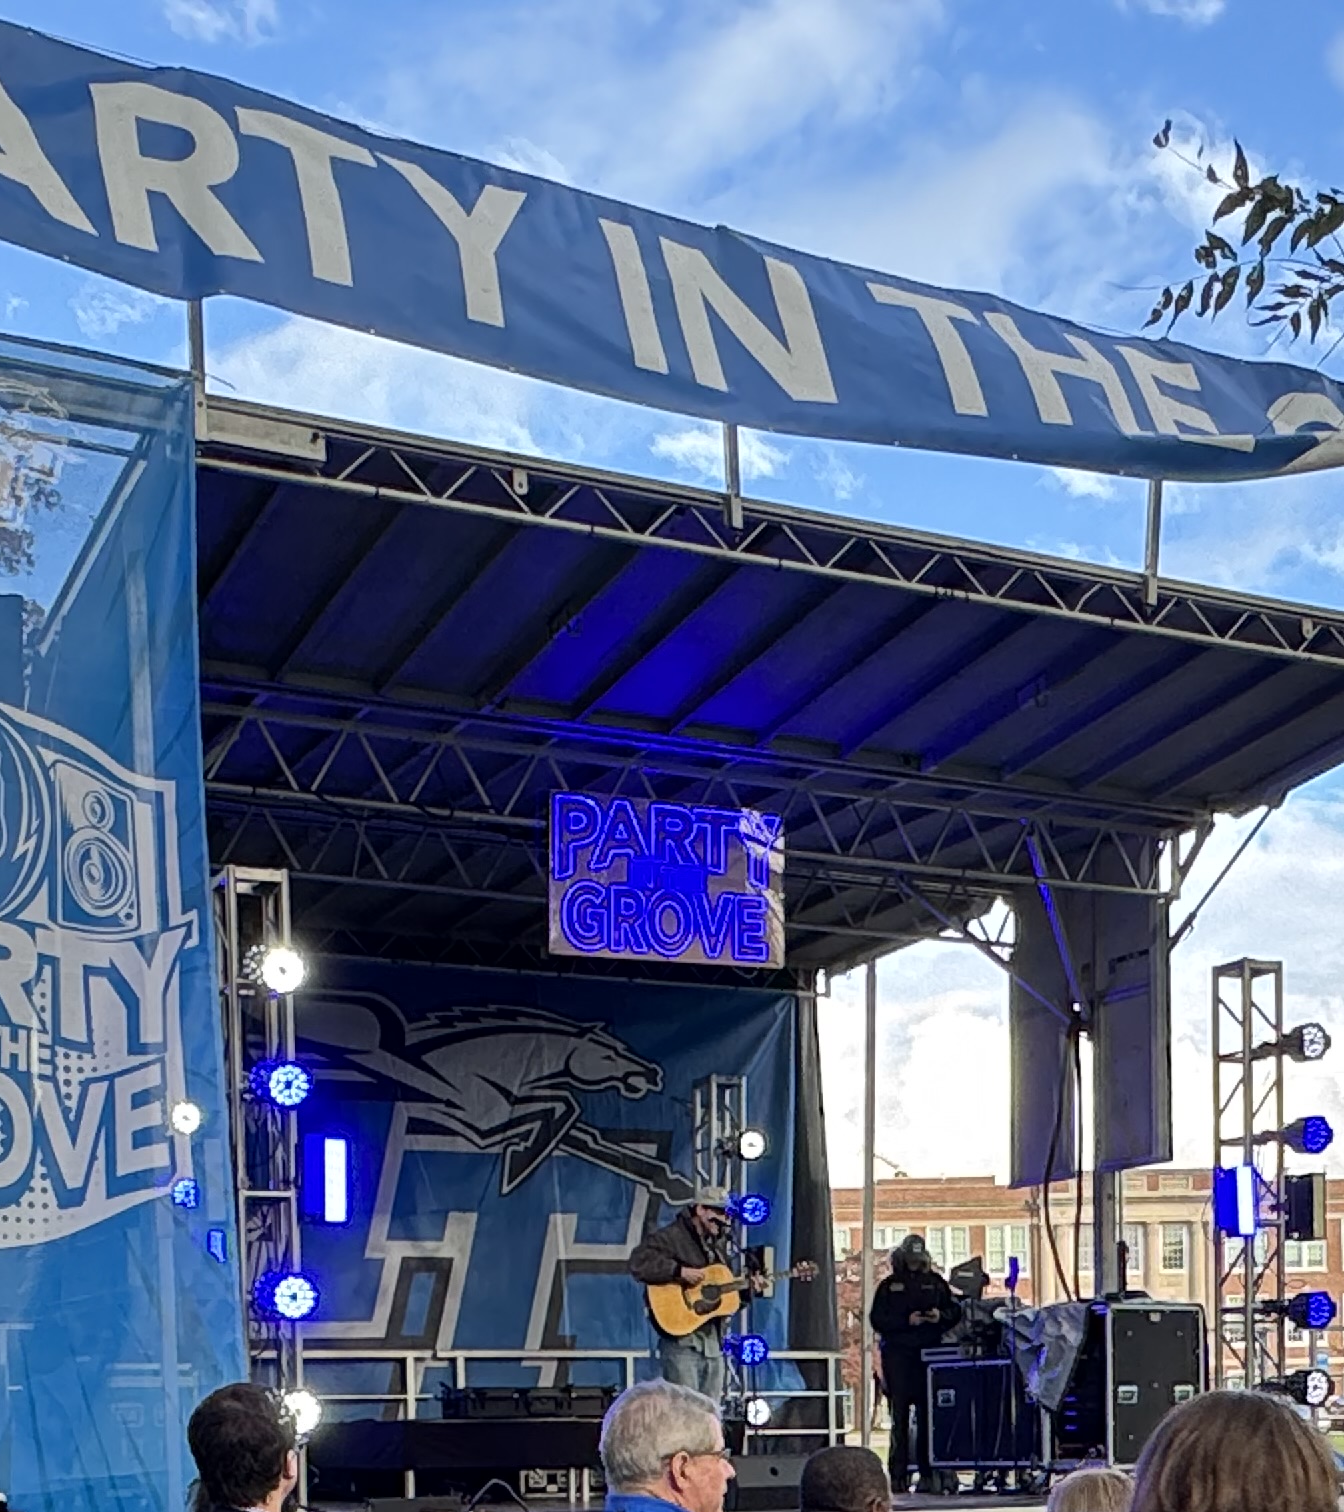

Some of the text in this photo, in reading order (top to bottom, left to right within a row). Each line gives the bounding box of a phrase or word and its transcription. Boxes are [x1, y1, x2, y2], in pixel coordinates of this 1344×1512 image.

[598, 216, 838, 403] IN
[869, 282, 1255, 453] THE
[551, 792, 783, 891] PARTY
[561, 880, 771, 962] GROVE
